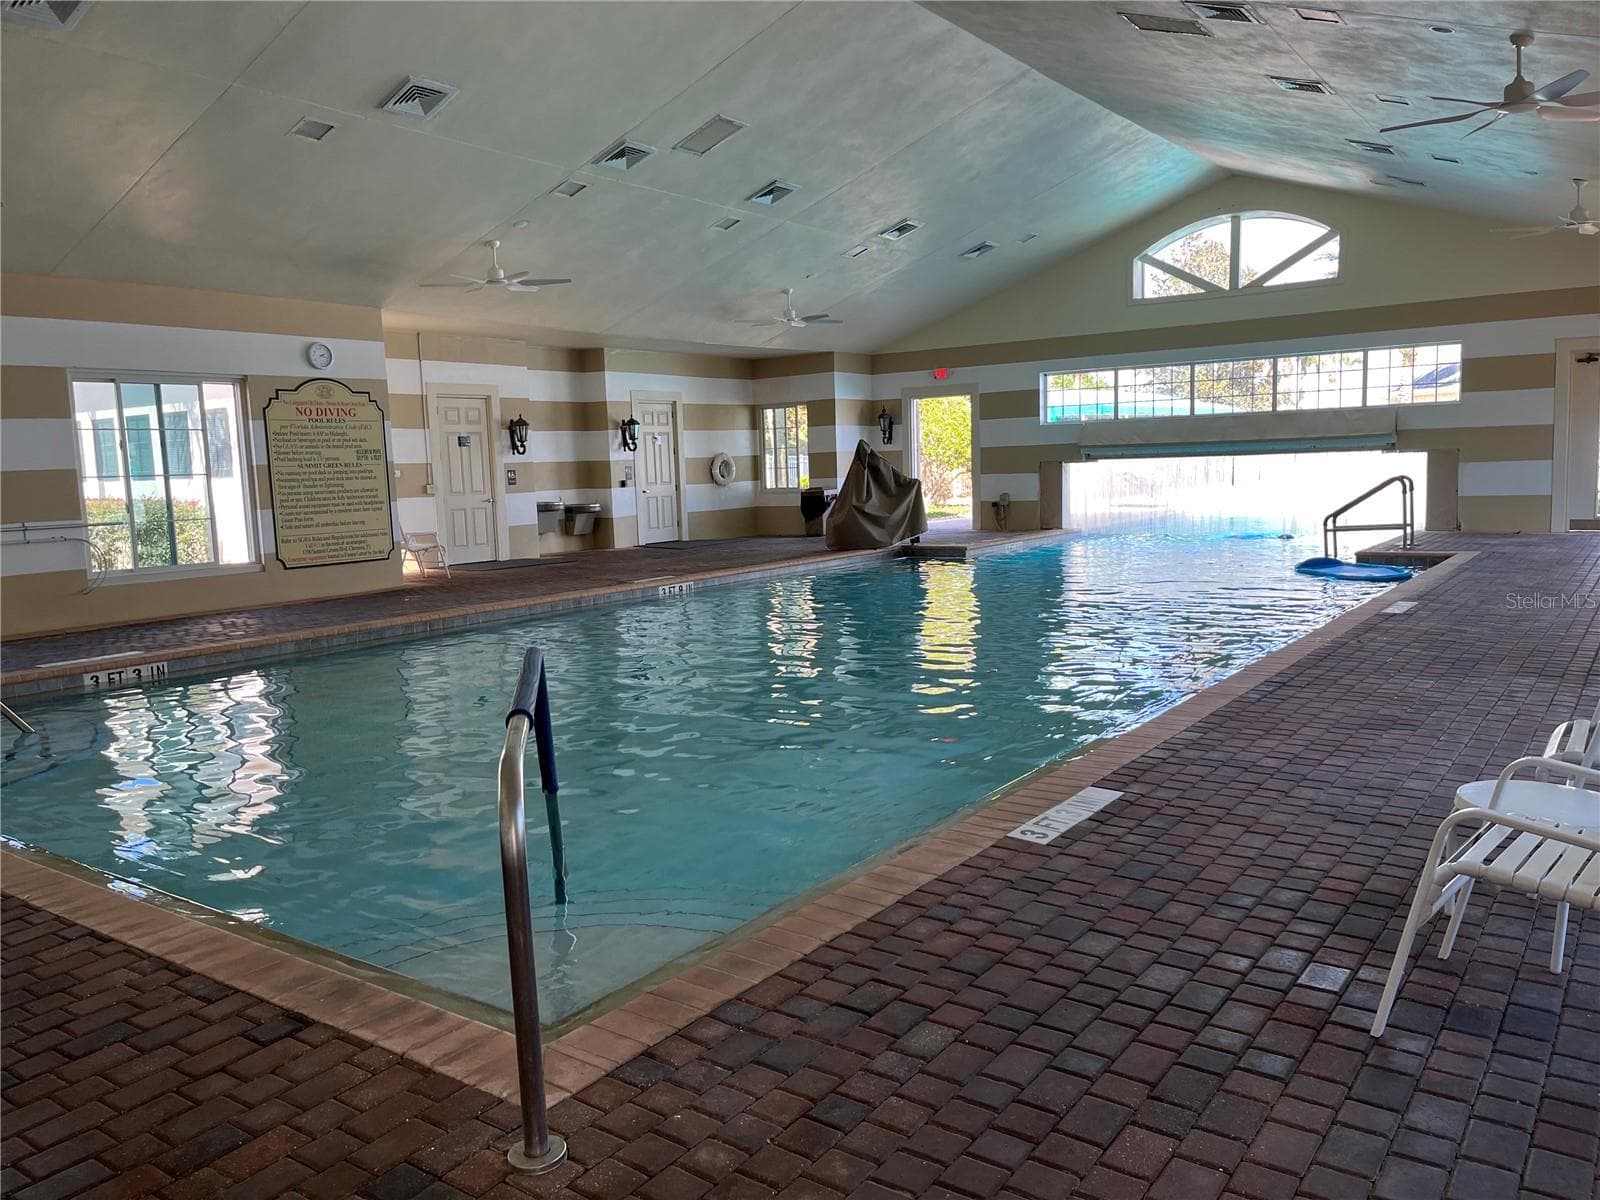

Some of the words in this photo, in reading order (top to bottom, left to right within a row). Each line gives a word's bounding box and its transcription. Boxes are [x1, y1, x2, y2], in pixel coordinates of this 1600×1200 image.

[296, 407, 313, 417] NO
[316, 408, 357, 418] DIVING
[90, 675, 100, 686] 3
[108, 670, 124, 684] FT
[132, 668, 142, 680] 3
[150, 664, 165, 680] IN
[1033, 816, 1069, 831] FT
[1020, 829, 1049, 840] 3
